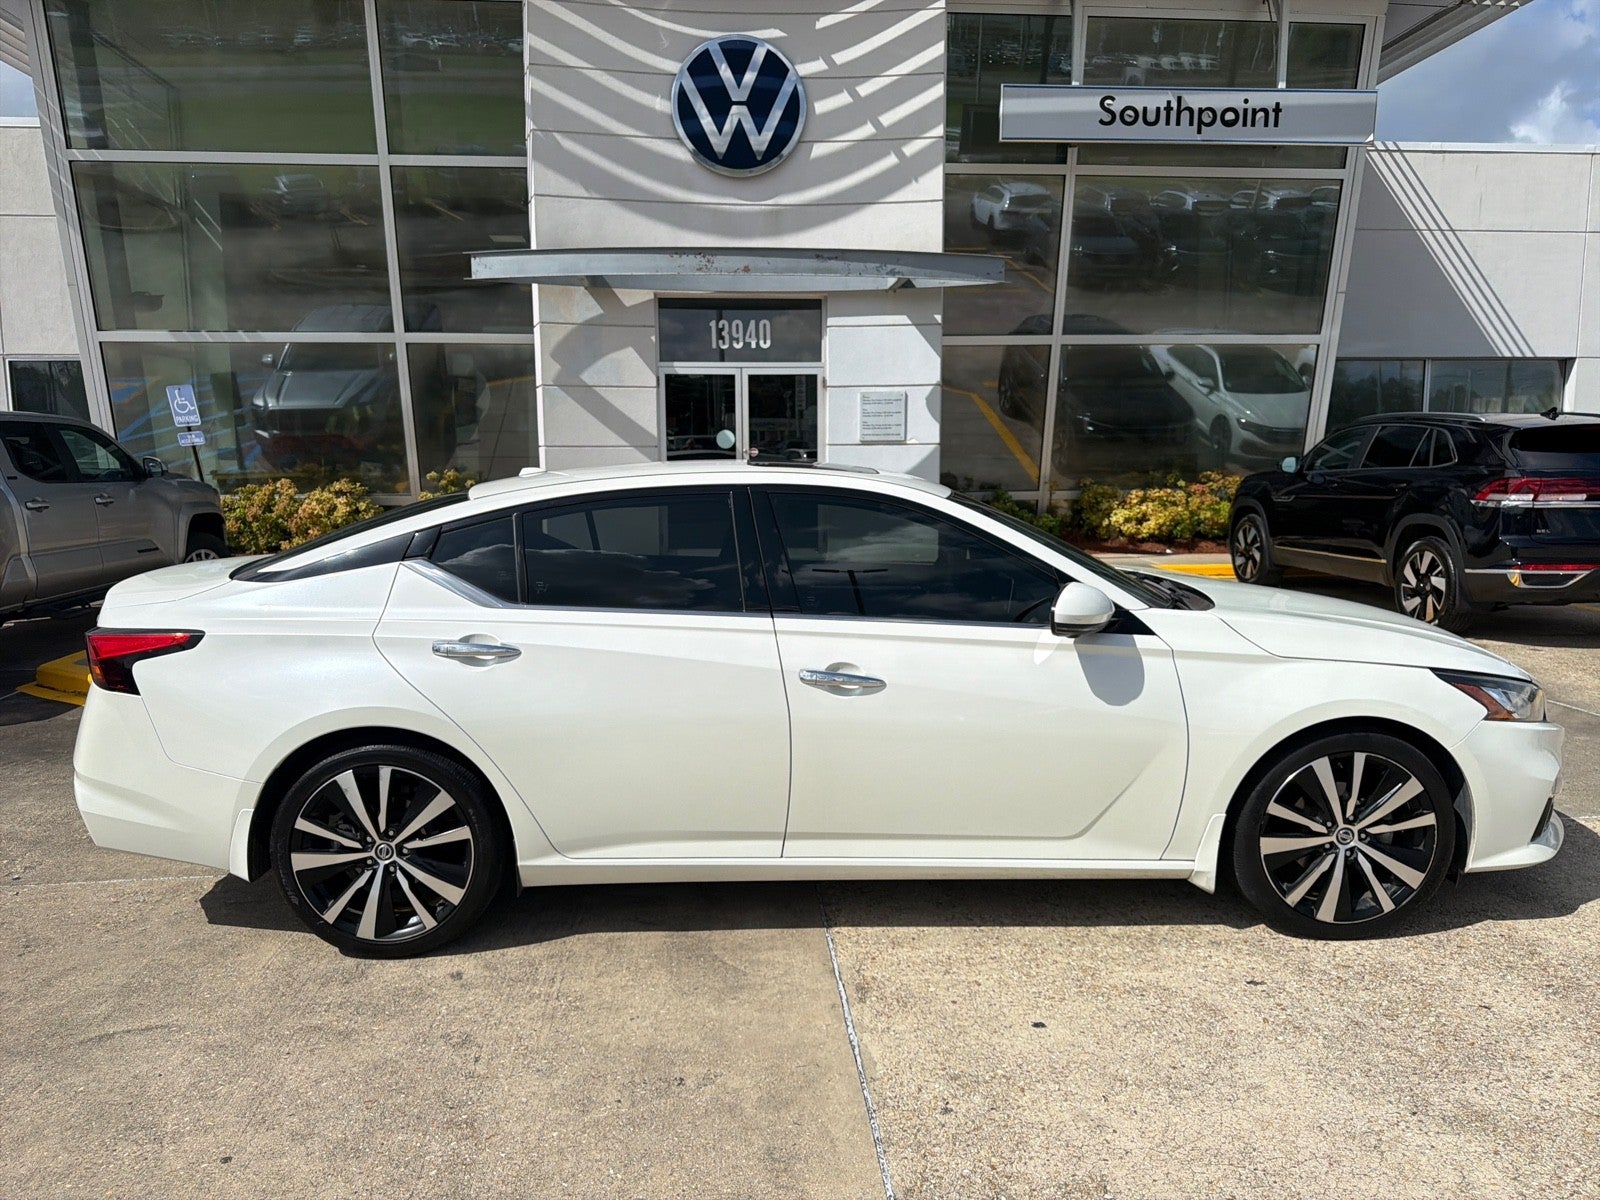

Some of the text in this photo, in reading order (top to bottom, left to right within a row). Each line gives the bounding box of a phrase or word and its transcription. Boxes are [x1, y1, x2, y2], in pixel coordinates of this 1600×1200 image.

[678, 39, 798, 161] VW
[1098, 95, 1283, 135] Southpoint
[709, 319, 771, 349] 13940
[176, 415, 199, 423] PARKING
